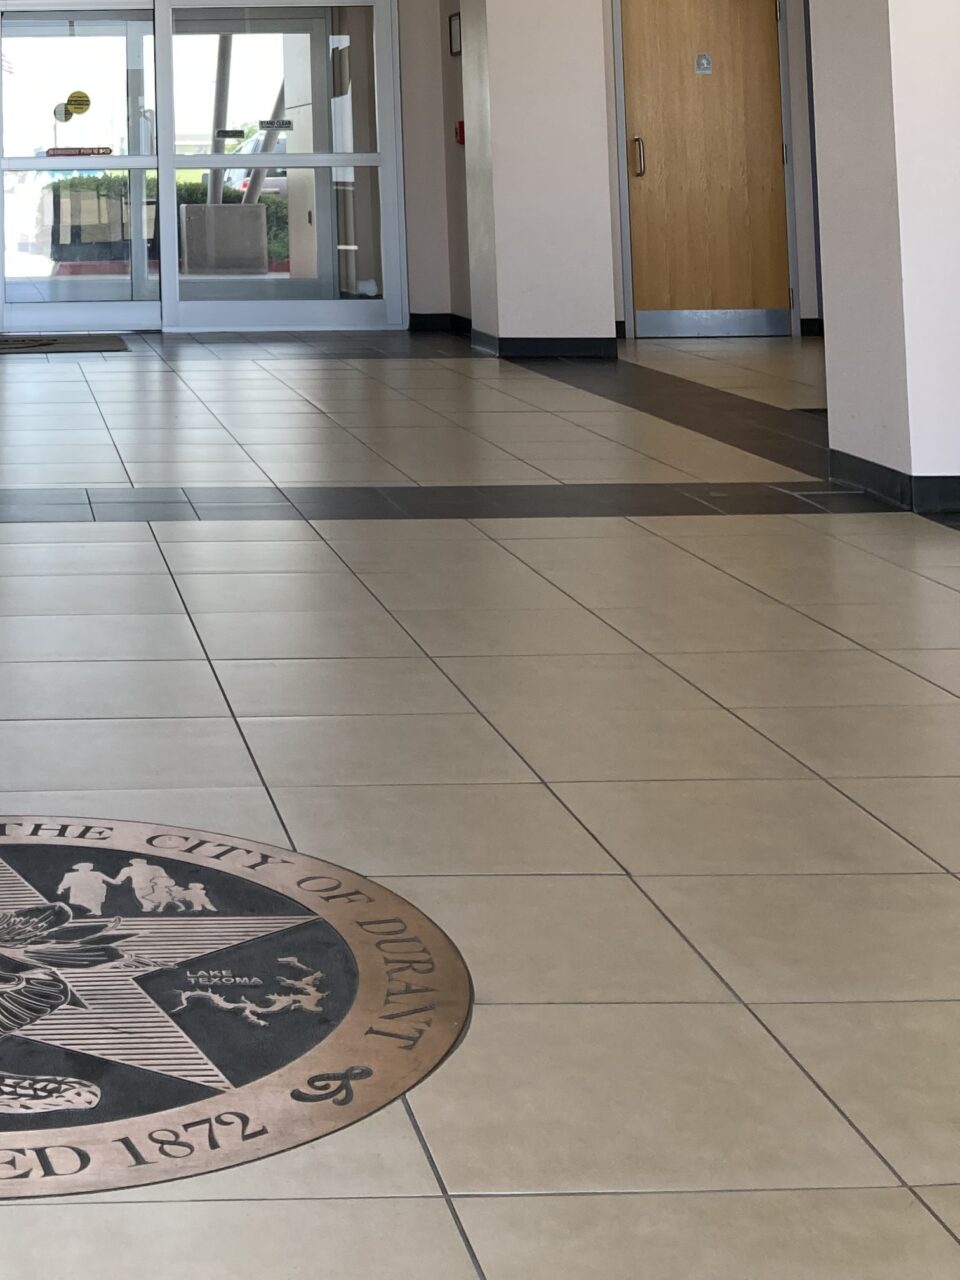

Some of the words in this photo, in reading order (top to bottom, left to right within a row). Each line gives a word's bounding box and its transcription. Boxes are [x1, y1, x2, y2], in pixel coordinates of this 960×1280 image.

[145, 833, 297, 871] CITY
[296, 875, 375, 905] OF
[356, 917, 441, 1051] DURANT
[187, 977, 263, 986] TEXOMA
[111, 1111, 270, 1168] 1872
